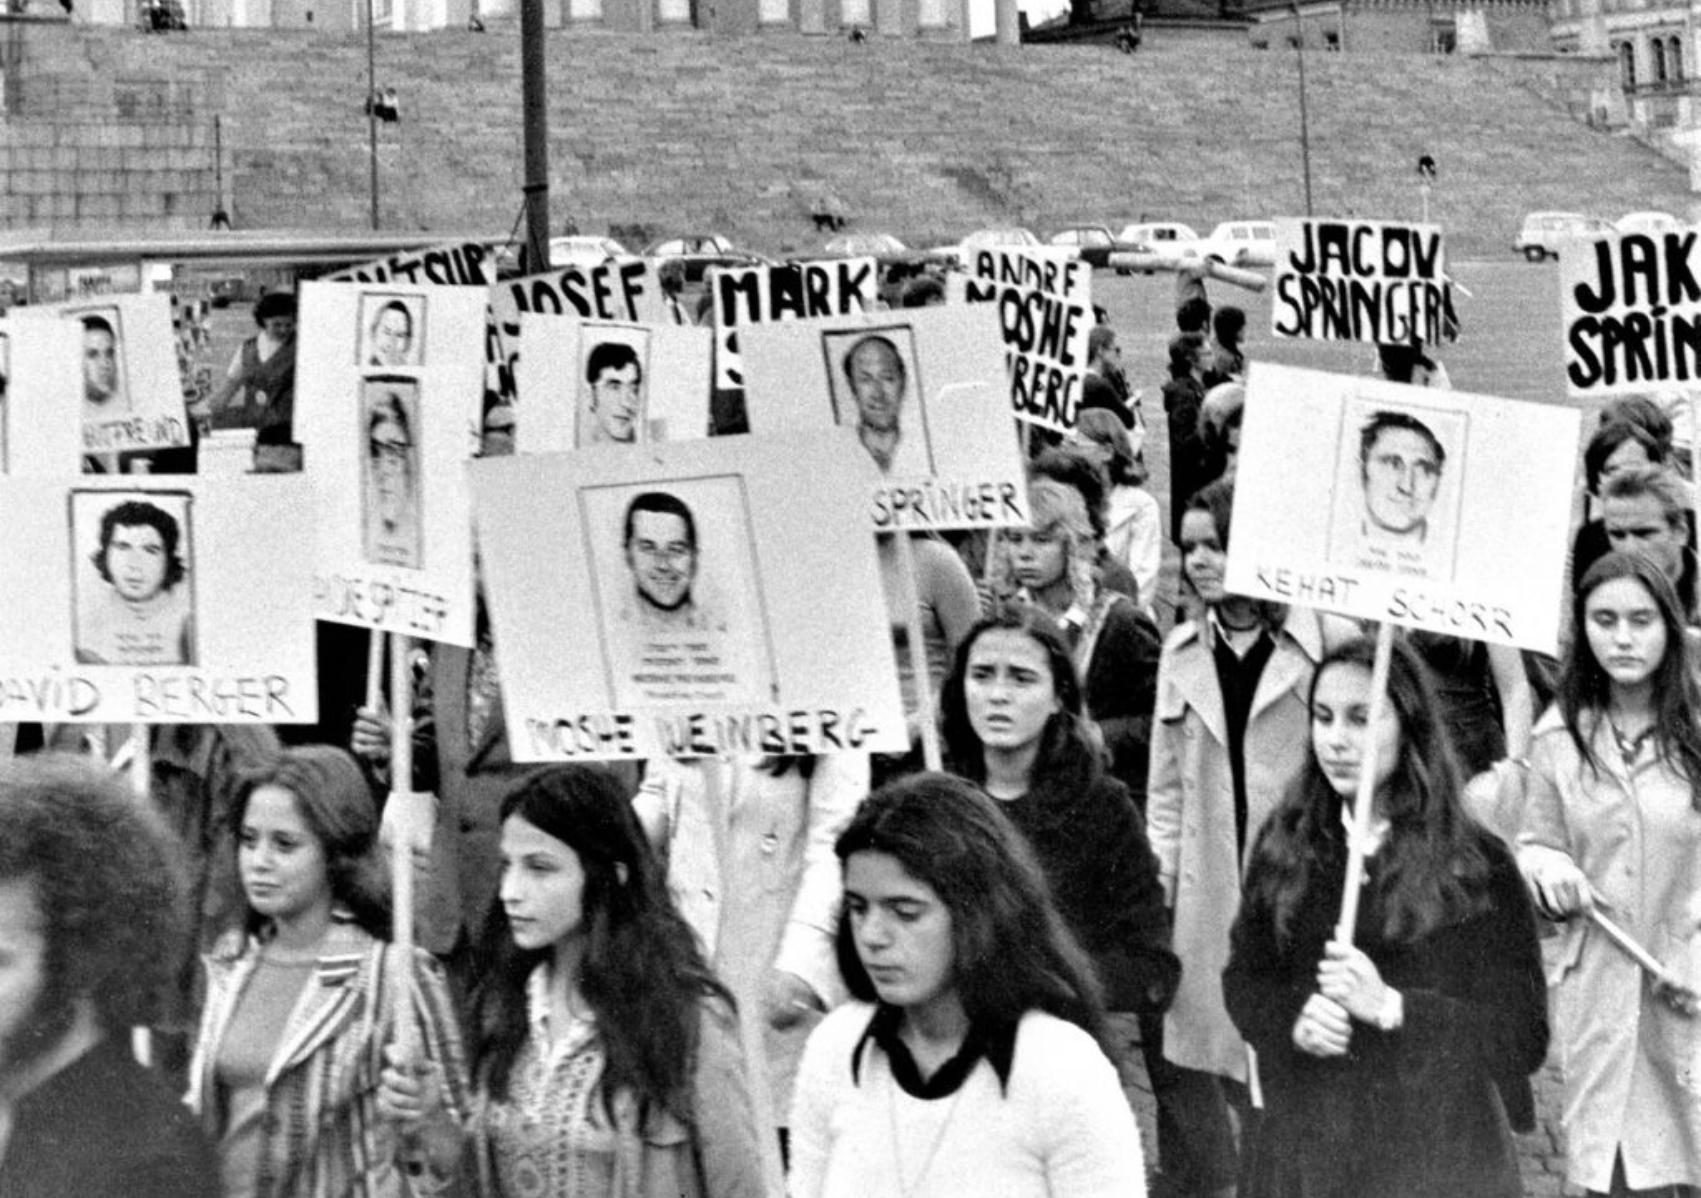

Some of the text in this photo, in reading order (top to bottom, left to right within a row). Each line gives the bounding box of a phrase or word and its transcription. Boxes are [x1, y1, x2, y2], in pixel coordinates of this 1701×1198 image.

[1289, 222, 1440, 279] JACOV
[1574, 232, 1701, 313] JAK
[719, 262, 870, 327] MARK
[0, 665, 294, 717] AVID BERGER
